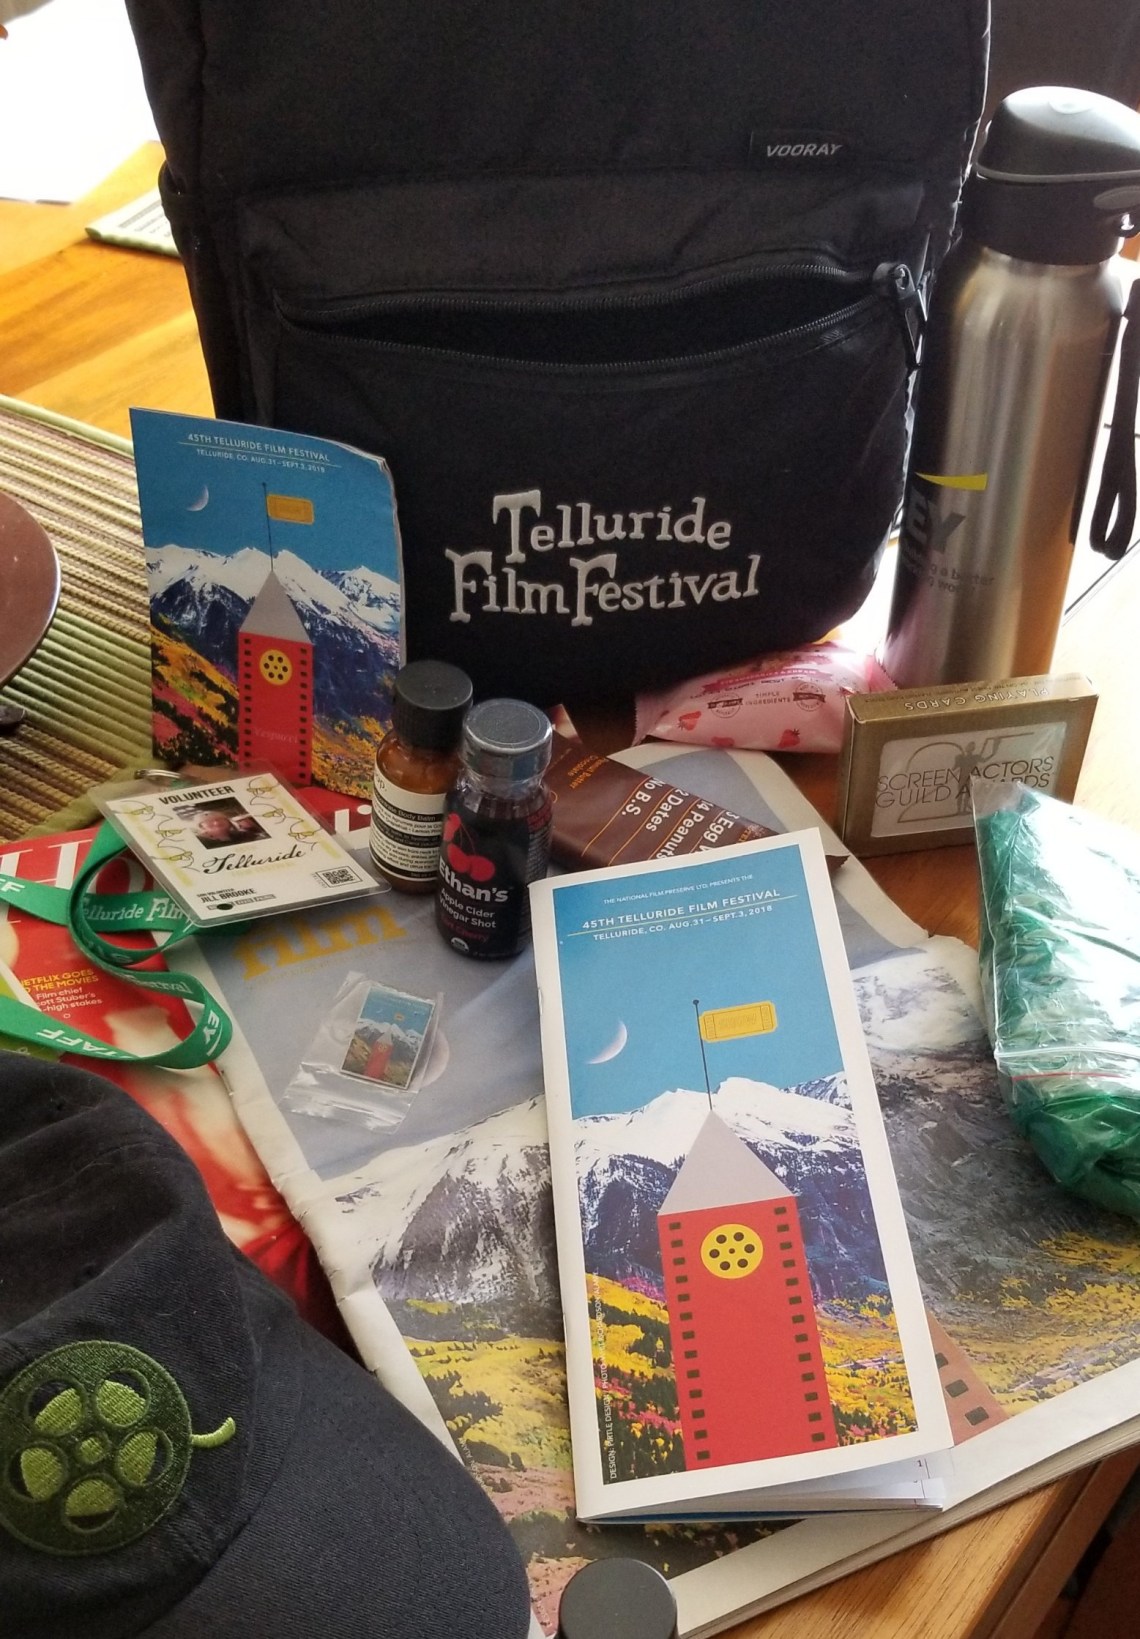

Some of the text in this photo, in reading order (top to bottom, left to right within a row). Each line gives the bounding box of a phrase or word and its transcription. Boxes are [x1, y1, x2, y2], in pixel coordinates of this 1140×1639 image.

[767, 143, 843, 157] VOORAY
[187, 433, 330, 462] 45TH TELLURIDE FILM FESTIVAL
[492, 489, 732, 563] Telluride
[445, 548, 761, 627] Film Festival
[745, 697, 791, 706] INGREDIENTS
[903, 697, 966, 711] CARDS
[974, 687, 1049, 703] PLAYING
[878, 756, 1056, 791] SCREEN ACTORS
[158, 785, 236, 806] VOLUNTEER
[621, 777, 666, 817] No B.S.
[875, 784, 951, 808] GUILD
[645, 787, 690, 833] 2 Dates
[655, 809, 705, 859] Peanuts
[703, 816, 735, 843] Egg
[202, 844, 306, 876] Telluride
[439, 855, 509, 903] Ethan's
[616, 892, 649, 904] NATIONAL
[649, 890, 664, 899] FILM
[664, 885, 695, 896] PRESERVE
[709, 877, 741, 888] PRESENTS
[741, 874, 753, 882] THE
[82, 896, 144, 922] elluride
[201, 896, 218, 904] JILL
[219, 888, 257, 900] BROOKE
[441, 887, 495, 919] Apple Cider
[582, 889, 780, 930] 45TH TELLURIDE FILM FESTIVAL
[439, 896, 497, 929] Vinegar Shot
[649, 923, 666, 934] CO.
[749, 904, 773, 916] 2018
[32, 982, 54, 992] THE
[56, 975, 98, 988] MOVIES
[62, 968, 94, 979] GOES
[36, 986, 82, 1000] Film chief
[55, 991, 96, 1002] Stuber's
[70, 998, 103, 1008] stakes
[204, 1010, 220, 1044] EY
[605, 1422, 613, 1447] PIRTLE
